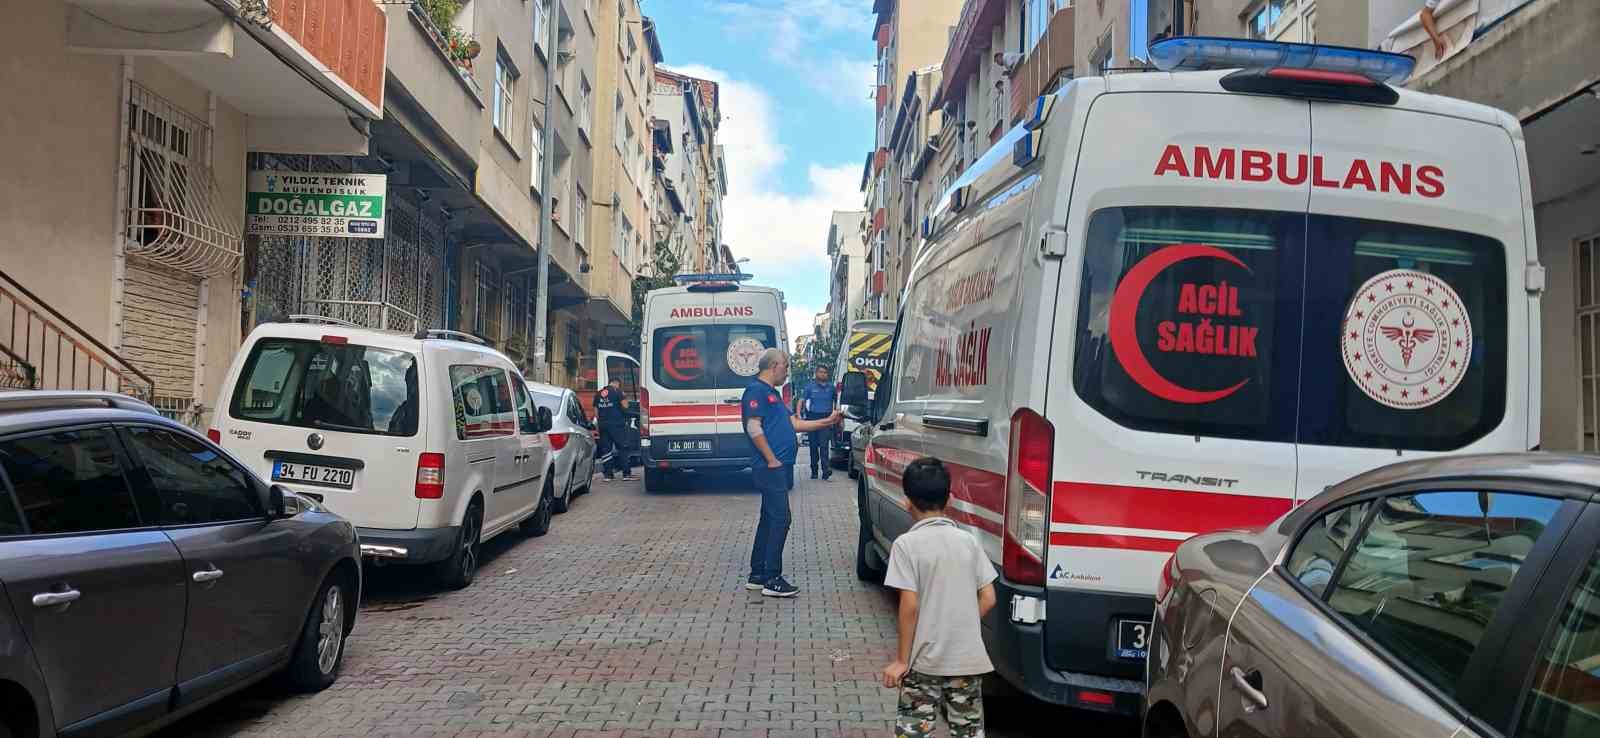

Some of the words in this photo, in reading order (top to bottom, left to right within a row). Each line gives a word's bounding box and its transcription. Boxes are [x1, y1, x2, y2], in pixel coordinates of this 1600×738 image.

[281, 175, 319, 185] YILDIZ
[322, 176, 366, 187] TEKNİK
[1153, 144, 1446, 199] AMBULANS
[258, 193, 373, 217] DOĞALGAZ
[254, 215, 269, 223] Tel:
[278, 216, 300, 224] 0212
[277, 224, 299, 232] 0533
[1178, 280, 1241, 316] ACİL
[670, 306, 753, 319] AMBULANS
[1157, 318, 1259, 357] SAĞLIK
[953, 320, 992, 387] SAĞLIK
[280, 463, 295, 478] 34
[302, 464, 319, 479] FU
[323, 468, 351, 484] 2210
[1135, 470, 1240, 488] TRANSIT
